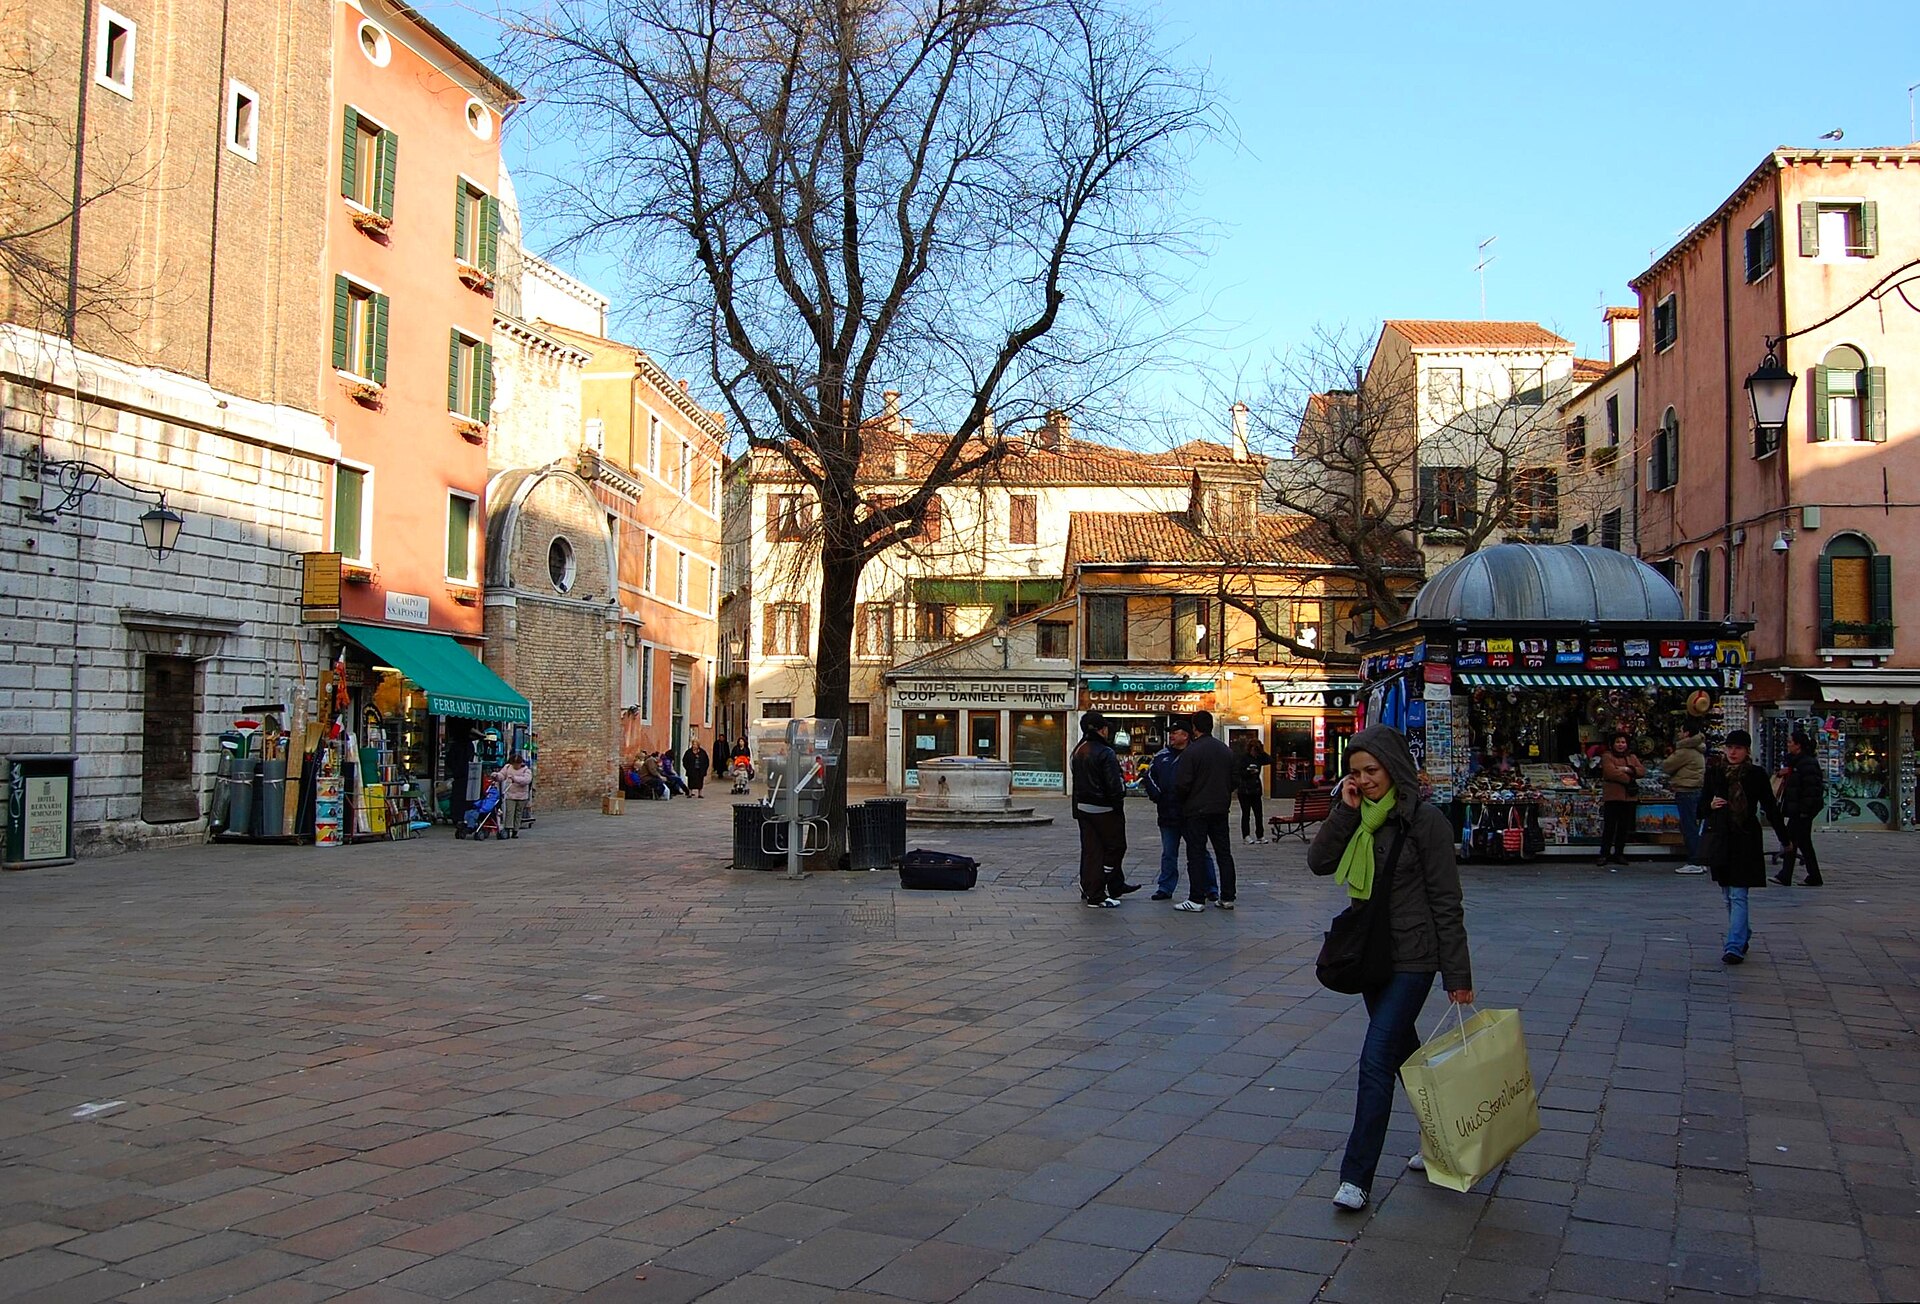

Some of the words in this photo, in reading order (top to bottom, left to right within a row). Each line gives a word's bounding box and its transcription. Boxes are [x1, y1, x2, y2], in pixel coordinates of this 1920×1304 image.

[396, 596, 419, 606] CAMPO
[914, 683, 961, 692] IMPR.
[970, 684, 1050, 693] FUNEBRE
[1154, 683, 1180, 691] SHOP
[898, 691, 940, 702] COOP.
[949, 692, 1007, 702] DANIELE
[1022, 693, 1065, 703] MANIN
[1272, 692, 1327, 707] PIZZA
[1333, 696, 1344, 706] e
[433, 698, 486, 716] FERRAMENTA
[488, 704, 527, 719] BATTISTIN
[1090, 703, 1138, 711] ARTICOLI
[1145, 703, 1166, 711] PER
[1171, 704, 1197, 712] CANI
